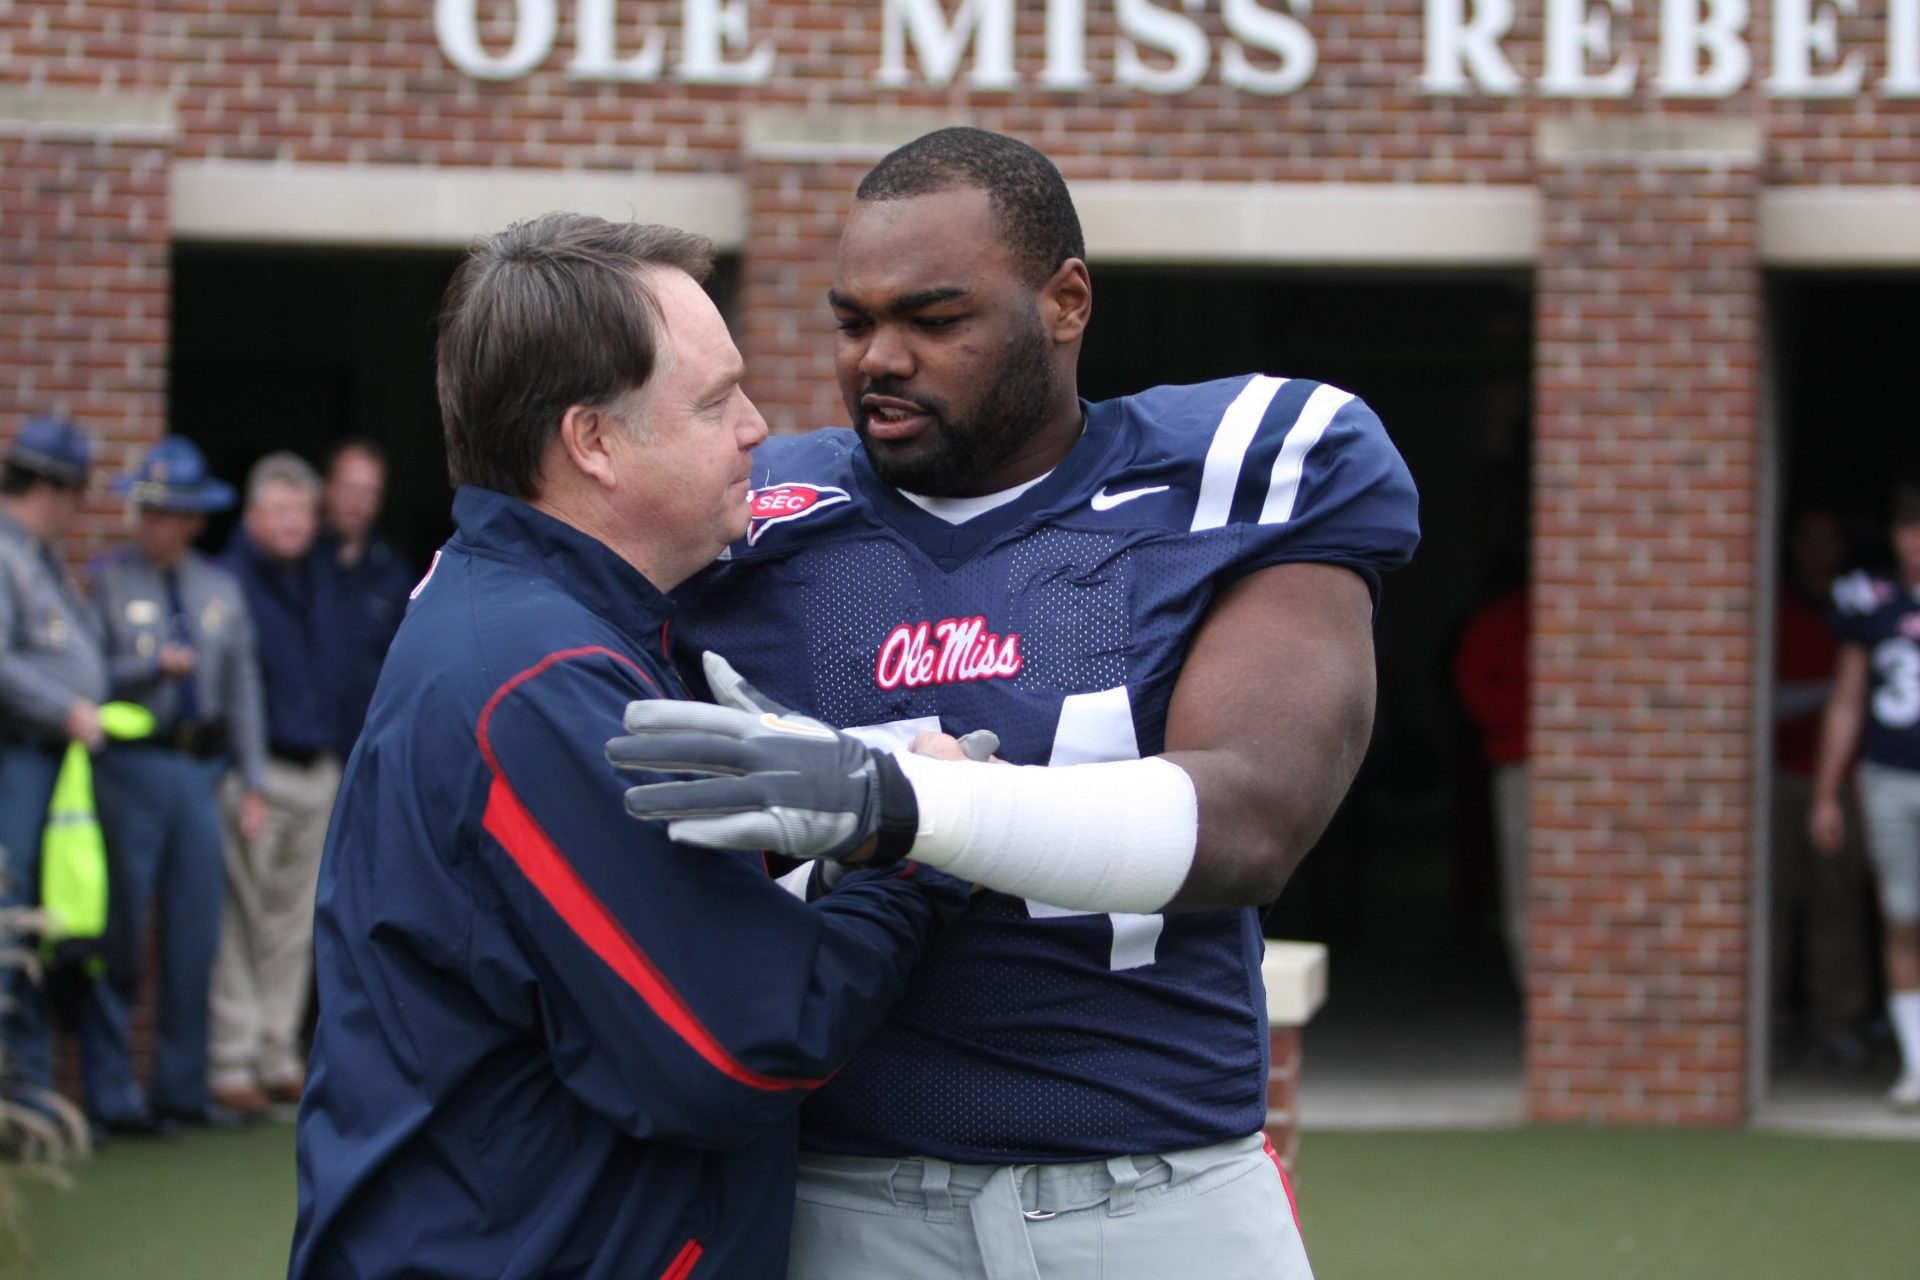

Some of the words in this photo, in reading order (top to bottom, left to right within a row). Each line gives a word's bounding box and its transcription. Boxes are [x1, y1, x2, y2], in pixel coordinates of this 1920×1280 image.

[433, 0, 777, 84] OLE
[874, 0, 1318, 95] MISS
[756, 495, 806, 510] SEC
[876, 624, 935, 688] Ole
[935, 616, 1022, 683] Miss
